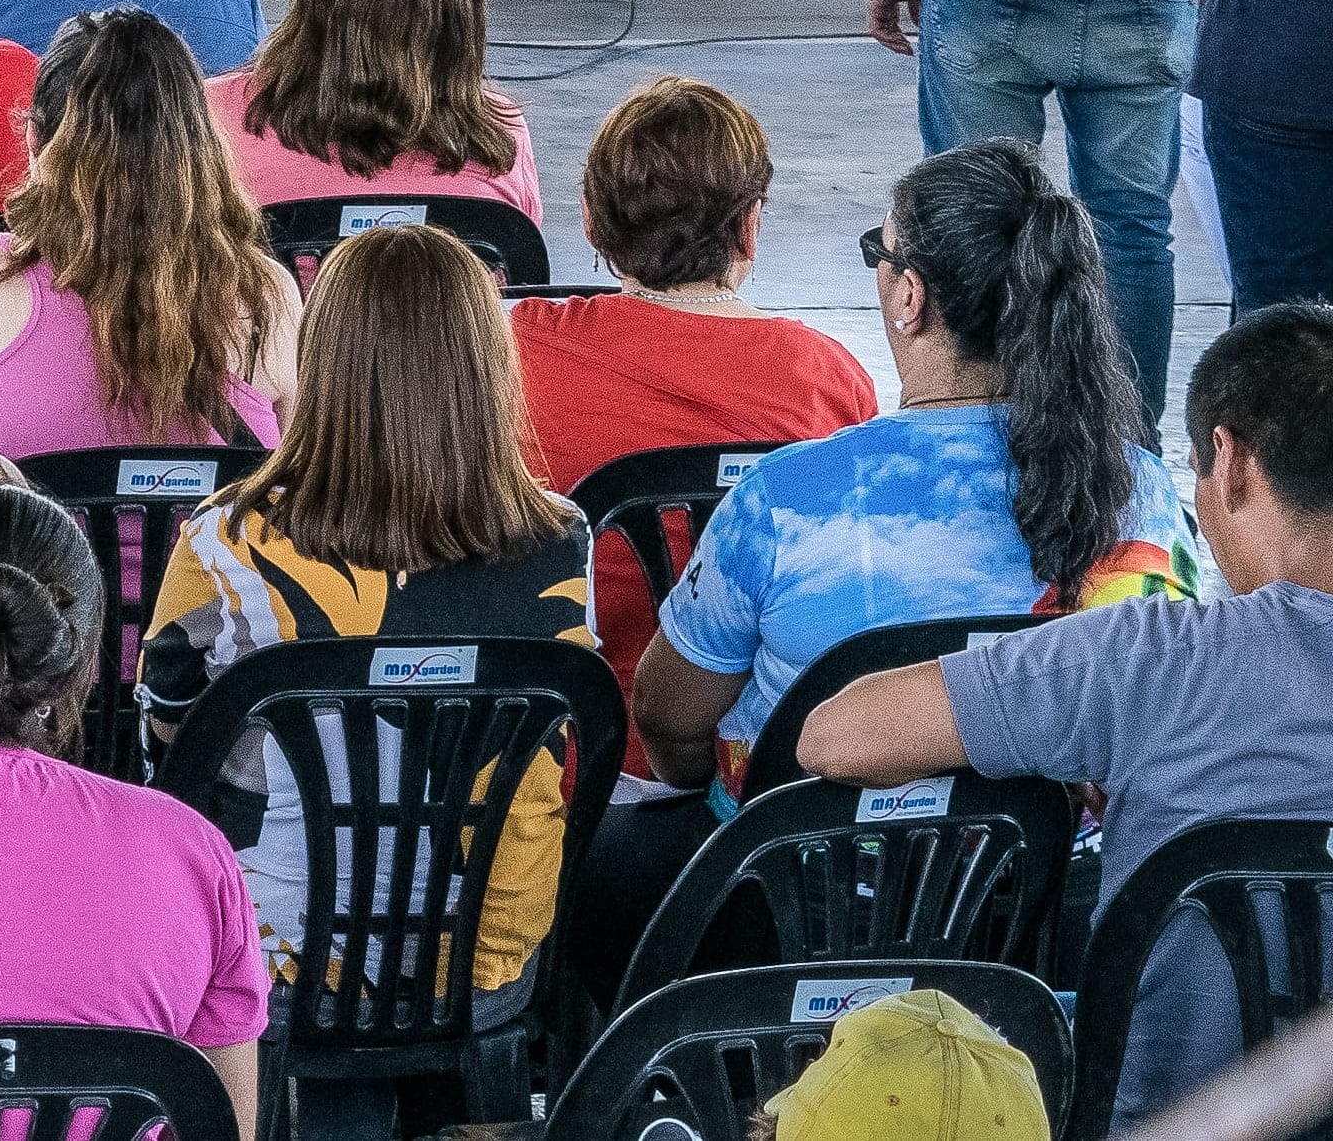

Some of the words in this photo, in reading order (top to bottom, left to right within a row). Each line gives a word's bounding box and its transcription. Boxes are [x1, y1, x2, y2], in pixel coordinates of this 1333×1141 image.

[130, 474, 202, 487] MAXgarden
[384, 663, 461, 677] MAXgarden
[871, 794, 937, 811] MAXgarden
